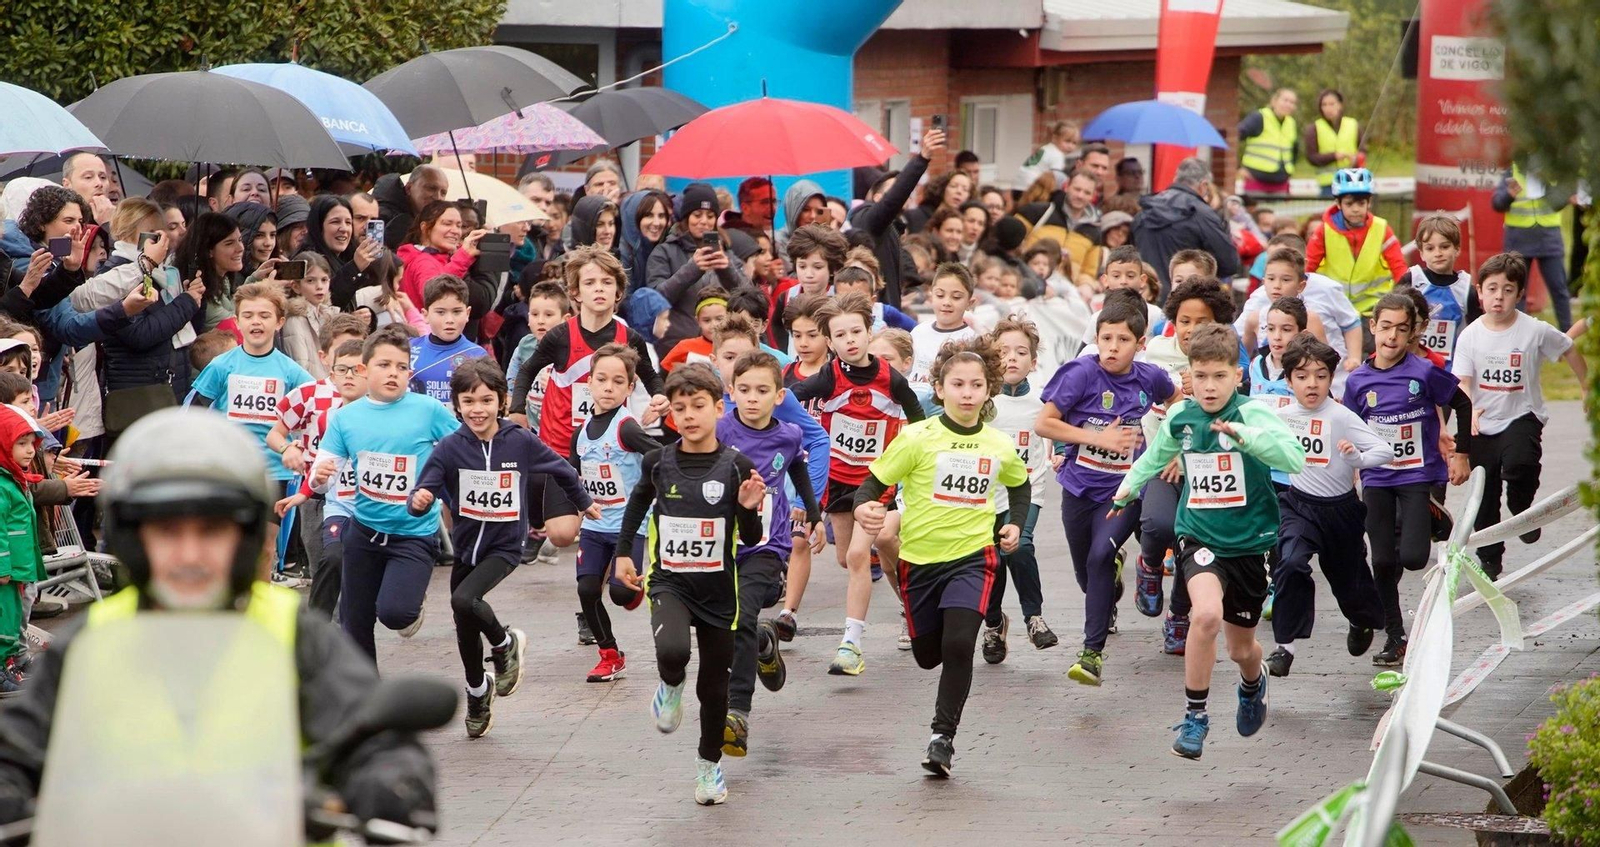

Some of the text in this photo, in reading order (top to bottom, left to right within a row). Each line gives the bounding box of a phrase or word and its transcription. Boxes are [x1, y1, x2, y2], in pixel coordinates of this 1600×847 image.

[1434, 45, 1500, 57] CONCELLO
[1440, 59, 1491, 72] DE VIGO
[1482, 368, 1522, 384] 4485
[233, 393, 277, 412] 4469
[1087, 416, 1103, 426] CEIP
[1379, 415, 1399, 424] CHANS
[835, 432, 878, 454] 4492
[1296, 435, 1324, 455] 90
[1388, 440, 1416, 458] 56
[1015, 448, 1029, 464] 4
[362, 470, 408, 492] 4473
[583, 479, 618, 497] 4498
[940, 473, 990, 495] 4488
[1191, 474, 1238, 494] 4452
[466, 490, 513, 508] 4464
[665, 539, 717, 558] 4457
